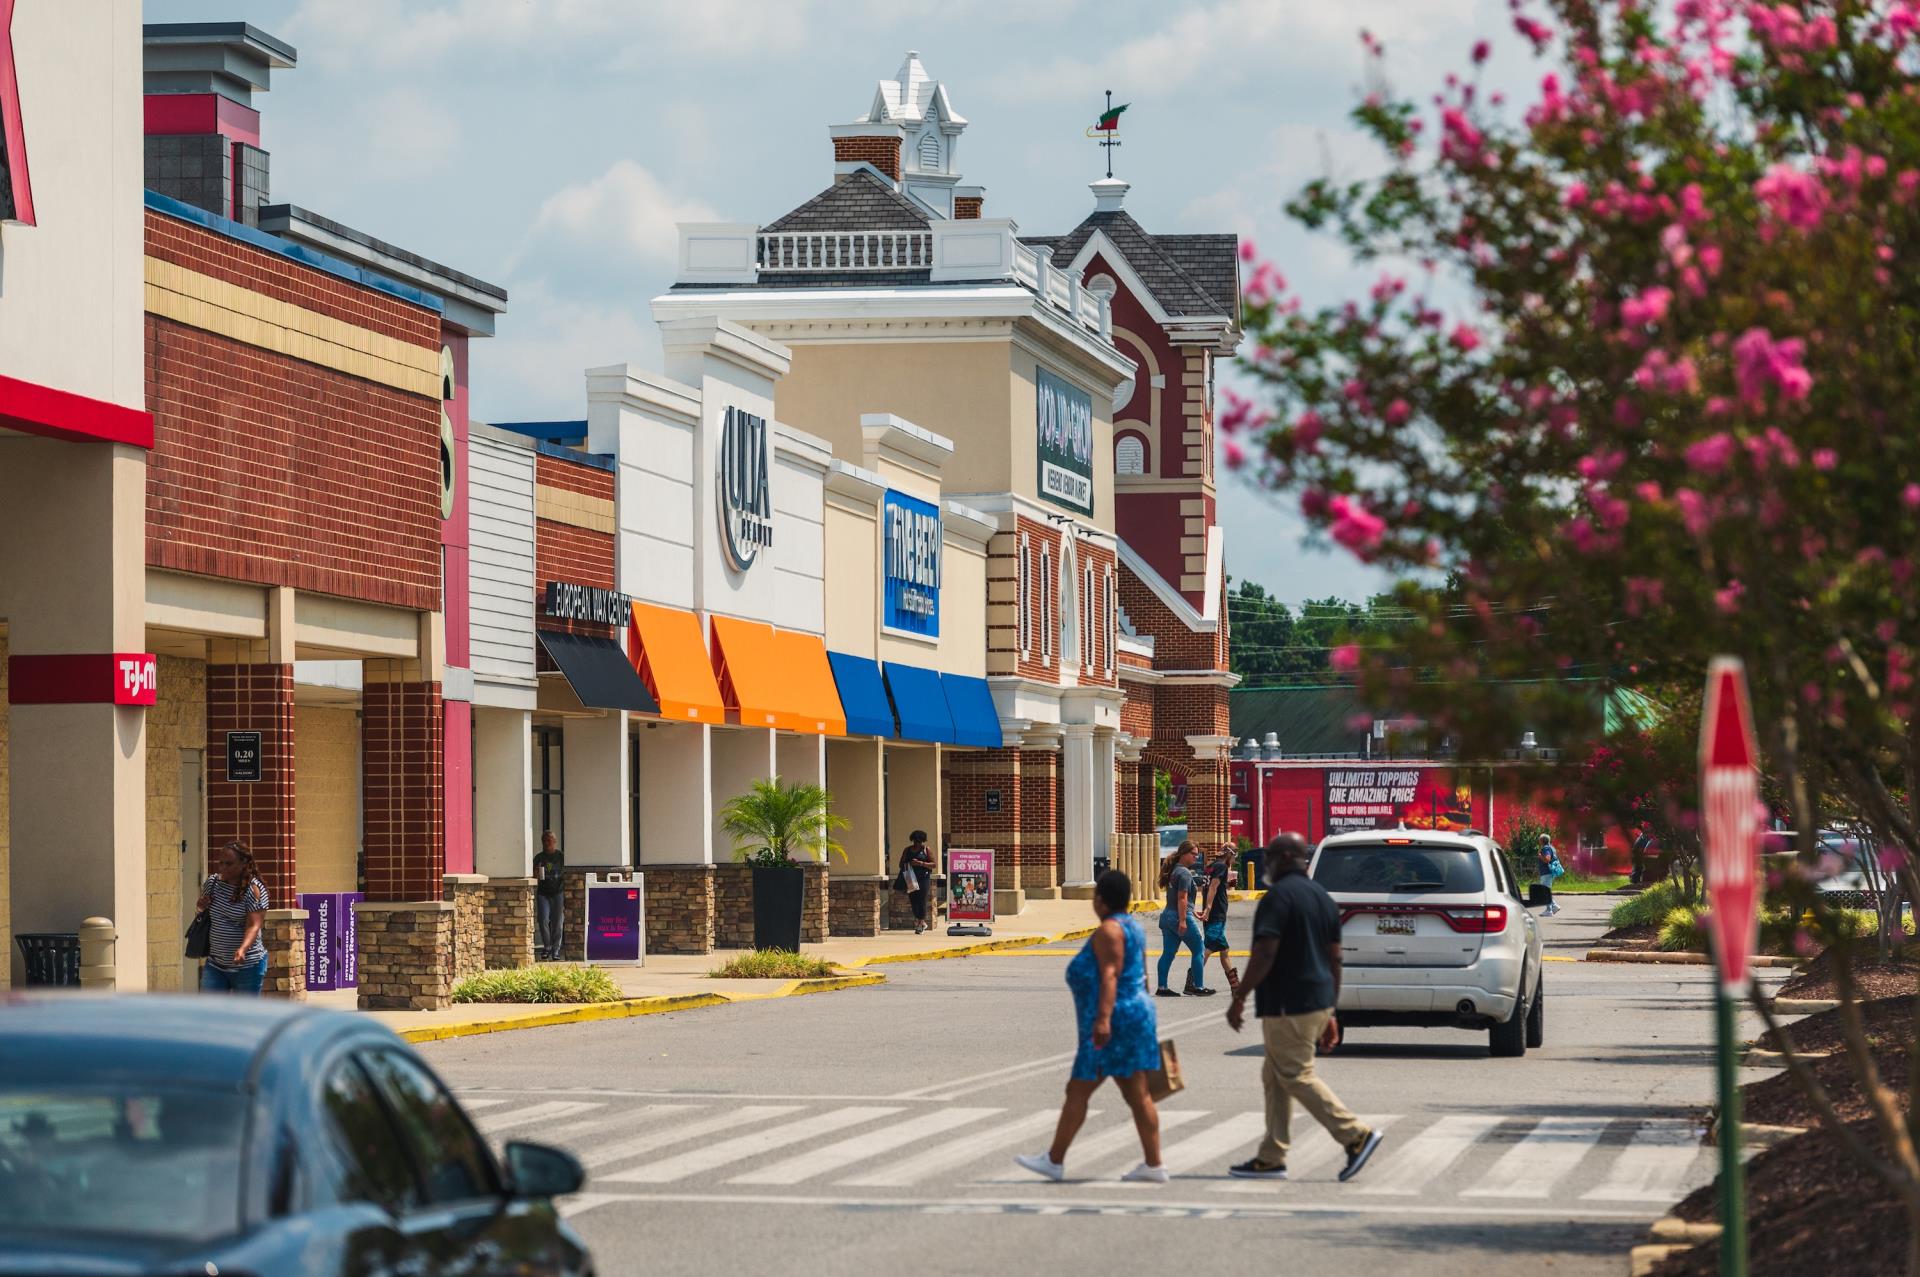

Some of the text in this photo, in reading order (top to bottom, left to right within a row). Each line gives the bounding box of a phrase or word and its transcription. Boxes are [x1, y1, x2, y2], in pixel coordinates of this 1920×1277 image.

[729, 405, 770, 519] ULTA
[741, 518, 773, 547] BEAUTY
[555, 582, 632, 627] EUROPEAN WAX CENTER
[234, 750, 254, 759] 0.20
[1329, 771, 1419, 787] UNLIMITED TOPPINGS
[1329, 787, 1416, 803] ONE AMAZING PRICE
[318, 899, 330, 984] Easy Rewards.
